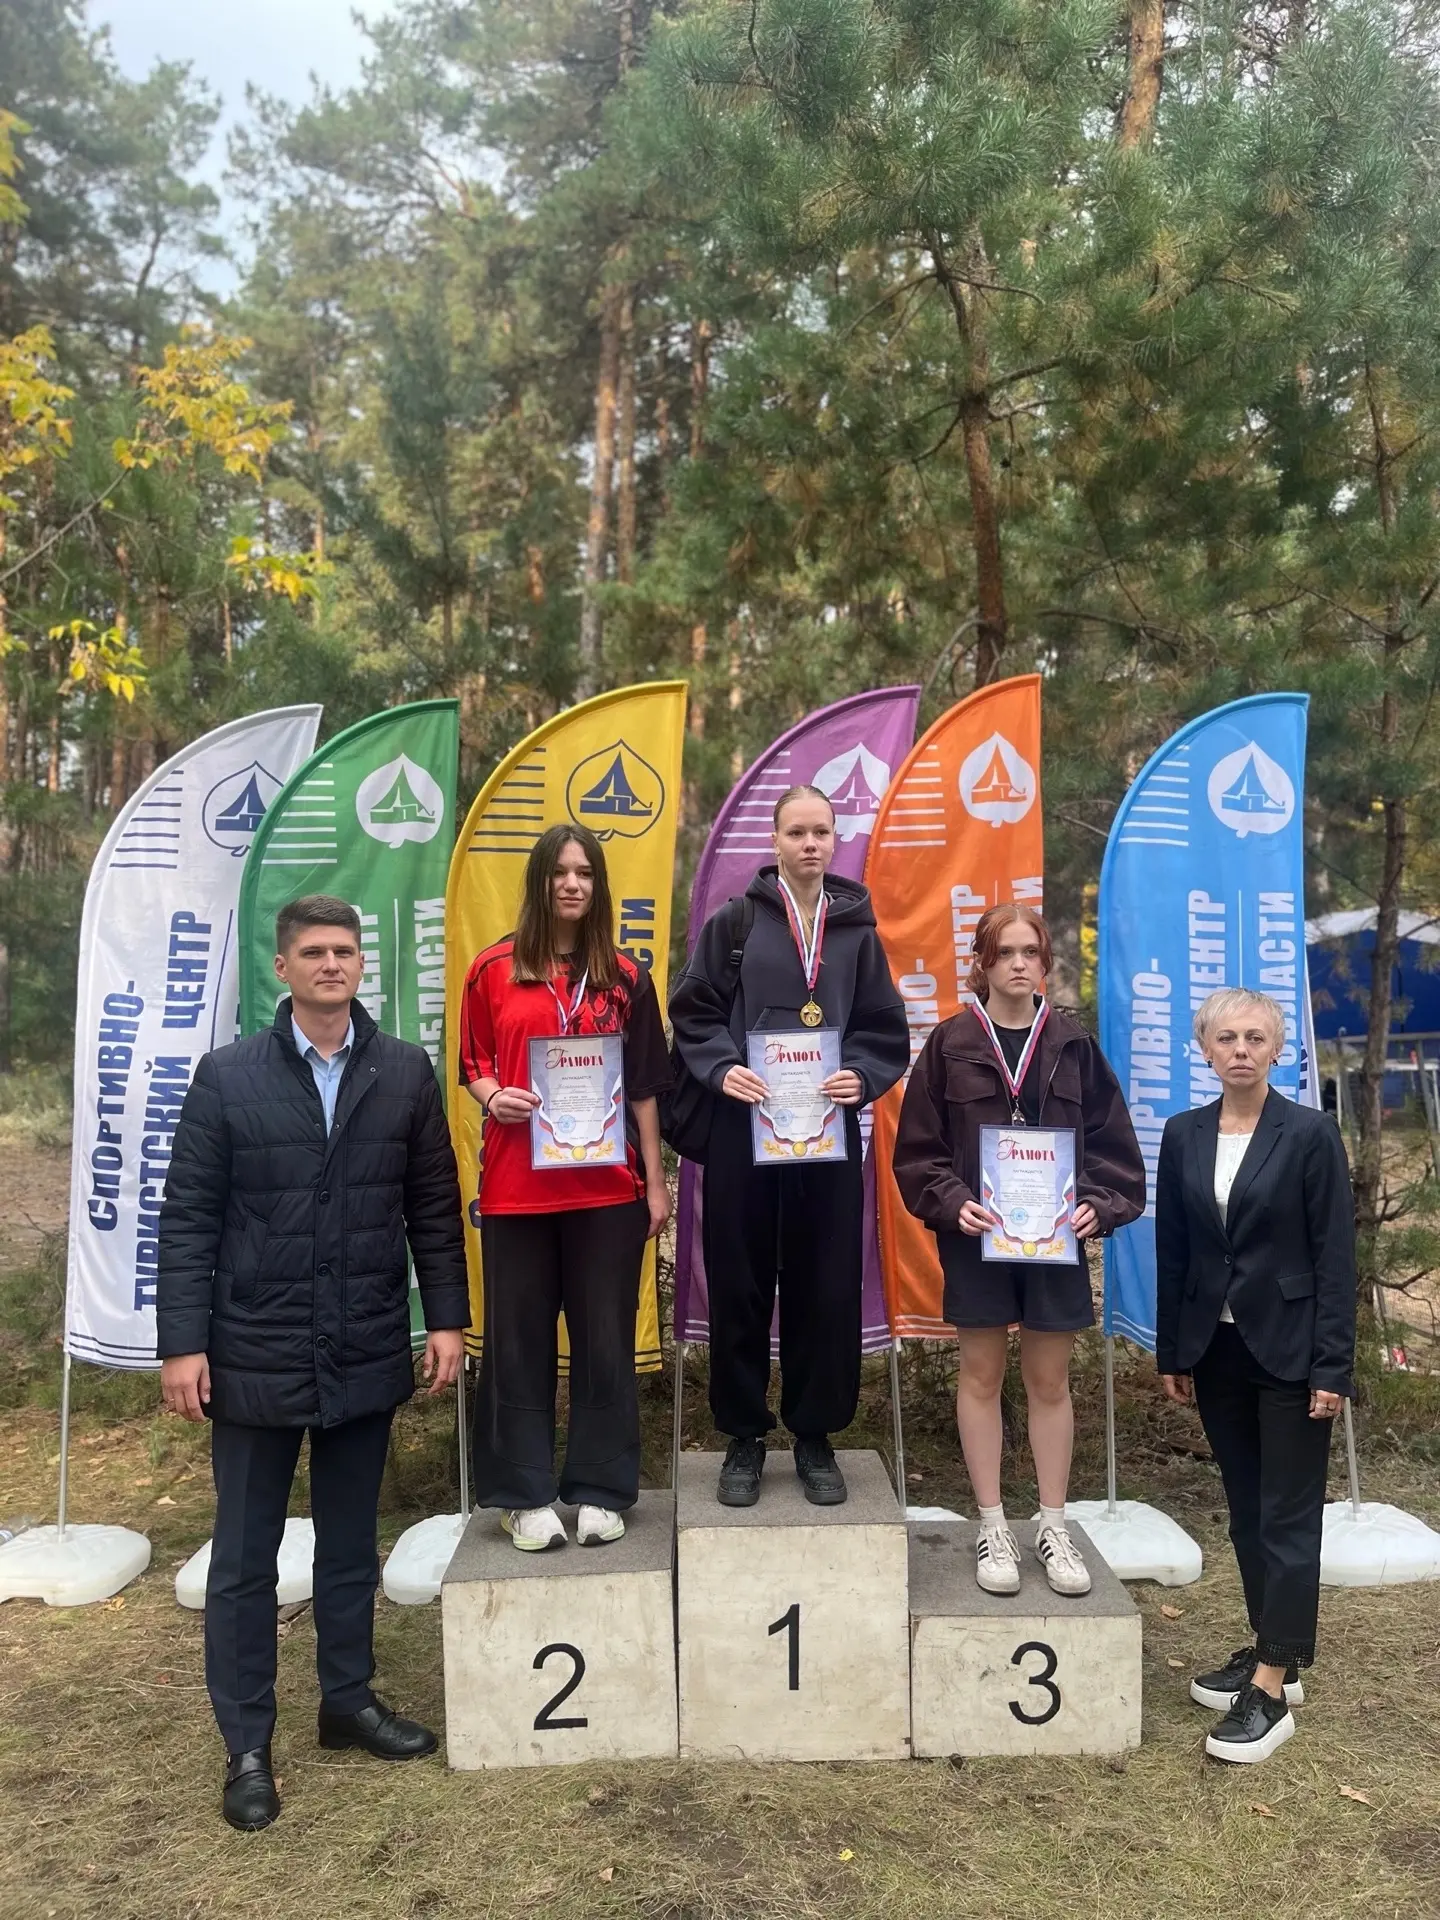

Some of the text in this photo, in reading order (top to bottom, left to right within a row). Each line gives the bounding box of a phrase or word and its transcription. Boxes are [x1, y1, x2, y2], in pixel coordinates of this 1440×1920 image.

[161, 910, 213, 1029] ЦЕНТР
[88, 980, 145, 1232] СПОРТИВНО-
[532, 1642, 588, 1730] 2
[768, 1603, 800, 1691] 1
[1008, 1640, 1062, 1725] 3
